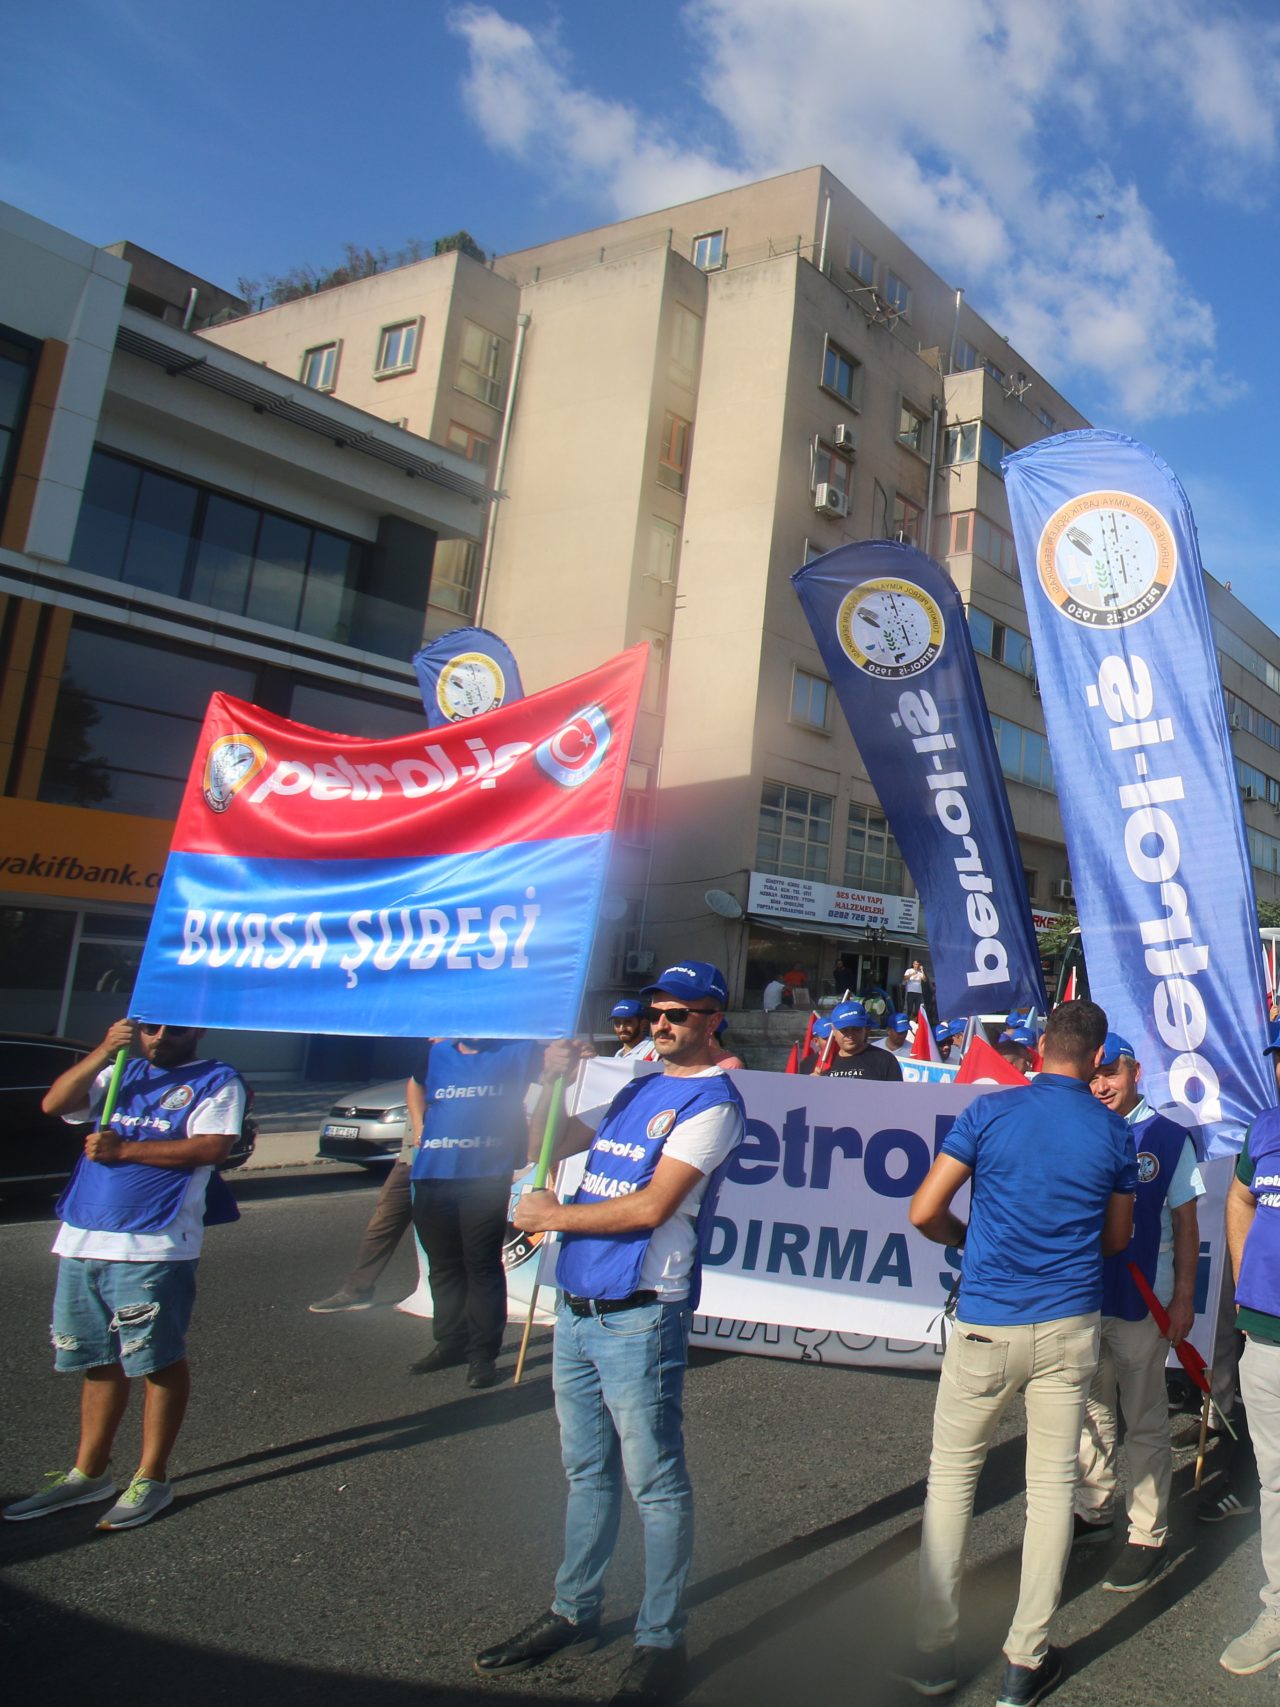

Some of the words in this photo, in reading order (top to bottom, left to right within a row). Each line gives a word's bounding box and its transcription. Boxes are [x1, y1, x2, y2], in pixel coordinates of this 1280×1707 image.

[247, 737, 533, 804] petrol-iş
[851, 893, 866, 901] CAN
[177, 908, 328, 969] BURSA
[339, 886, 542, 989] ŞUBESİ
